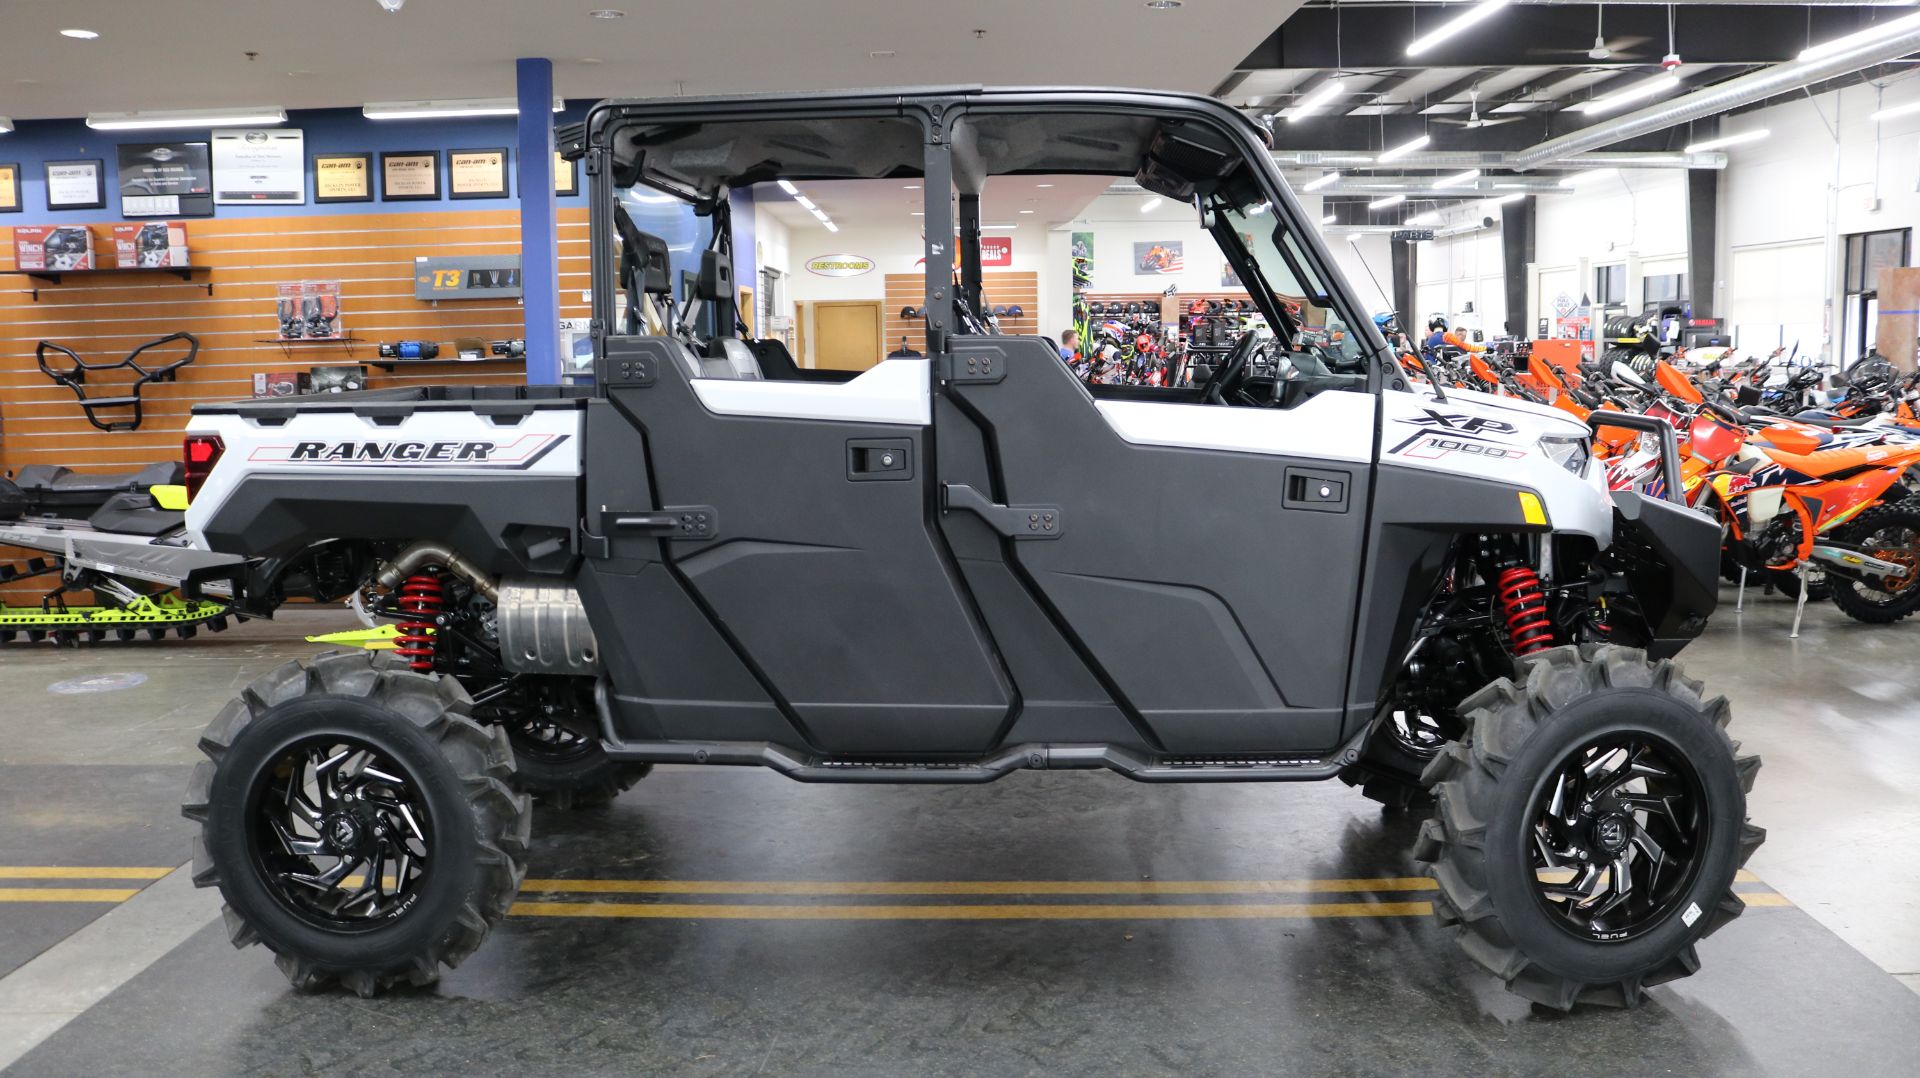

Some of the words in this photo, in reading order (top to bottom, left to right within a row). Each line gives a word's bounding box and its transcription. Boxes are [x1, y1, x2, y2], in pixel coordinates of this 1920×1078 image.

[1393, 230, 1433, 239] PARTS
[811, 261, 869, 270] RESTROOMS
[432, 269, 461, 287] T3
[560, 321, 591, 329] GARM
[1395, 406, 1518, 434] XP
[290, 440, 495, 462] RANGER
[1427, 438, 1507, 458] 1000
[387, 893, 418, 918] FUEL
[1592, 931, 1628, 940] FUEL
